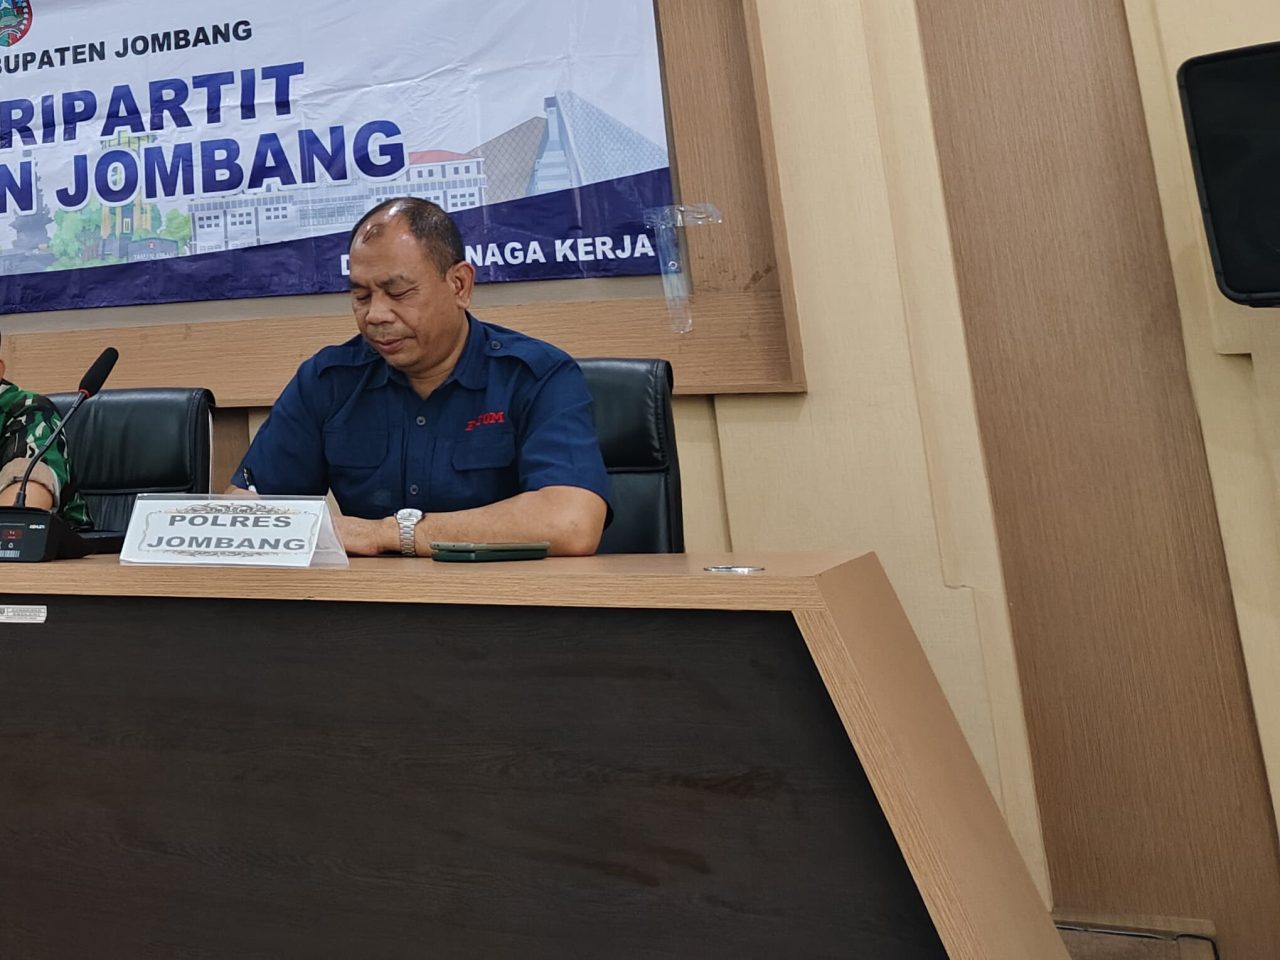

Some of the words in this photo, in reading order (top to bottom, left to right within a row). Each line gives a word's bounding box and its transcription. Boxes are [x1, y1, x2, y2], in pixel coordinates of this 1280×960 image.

[114, 19, 253, 59] JOMBANG
[56, 119, 406, 208] JOMBANG
[464, 240, 546, 267] NAGA
[554, 233, 656, 262] KERJA
[167, 514, 292, 528] POLRES
[146, 535, 306, 551] JOMBANG
